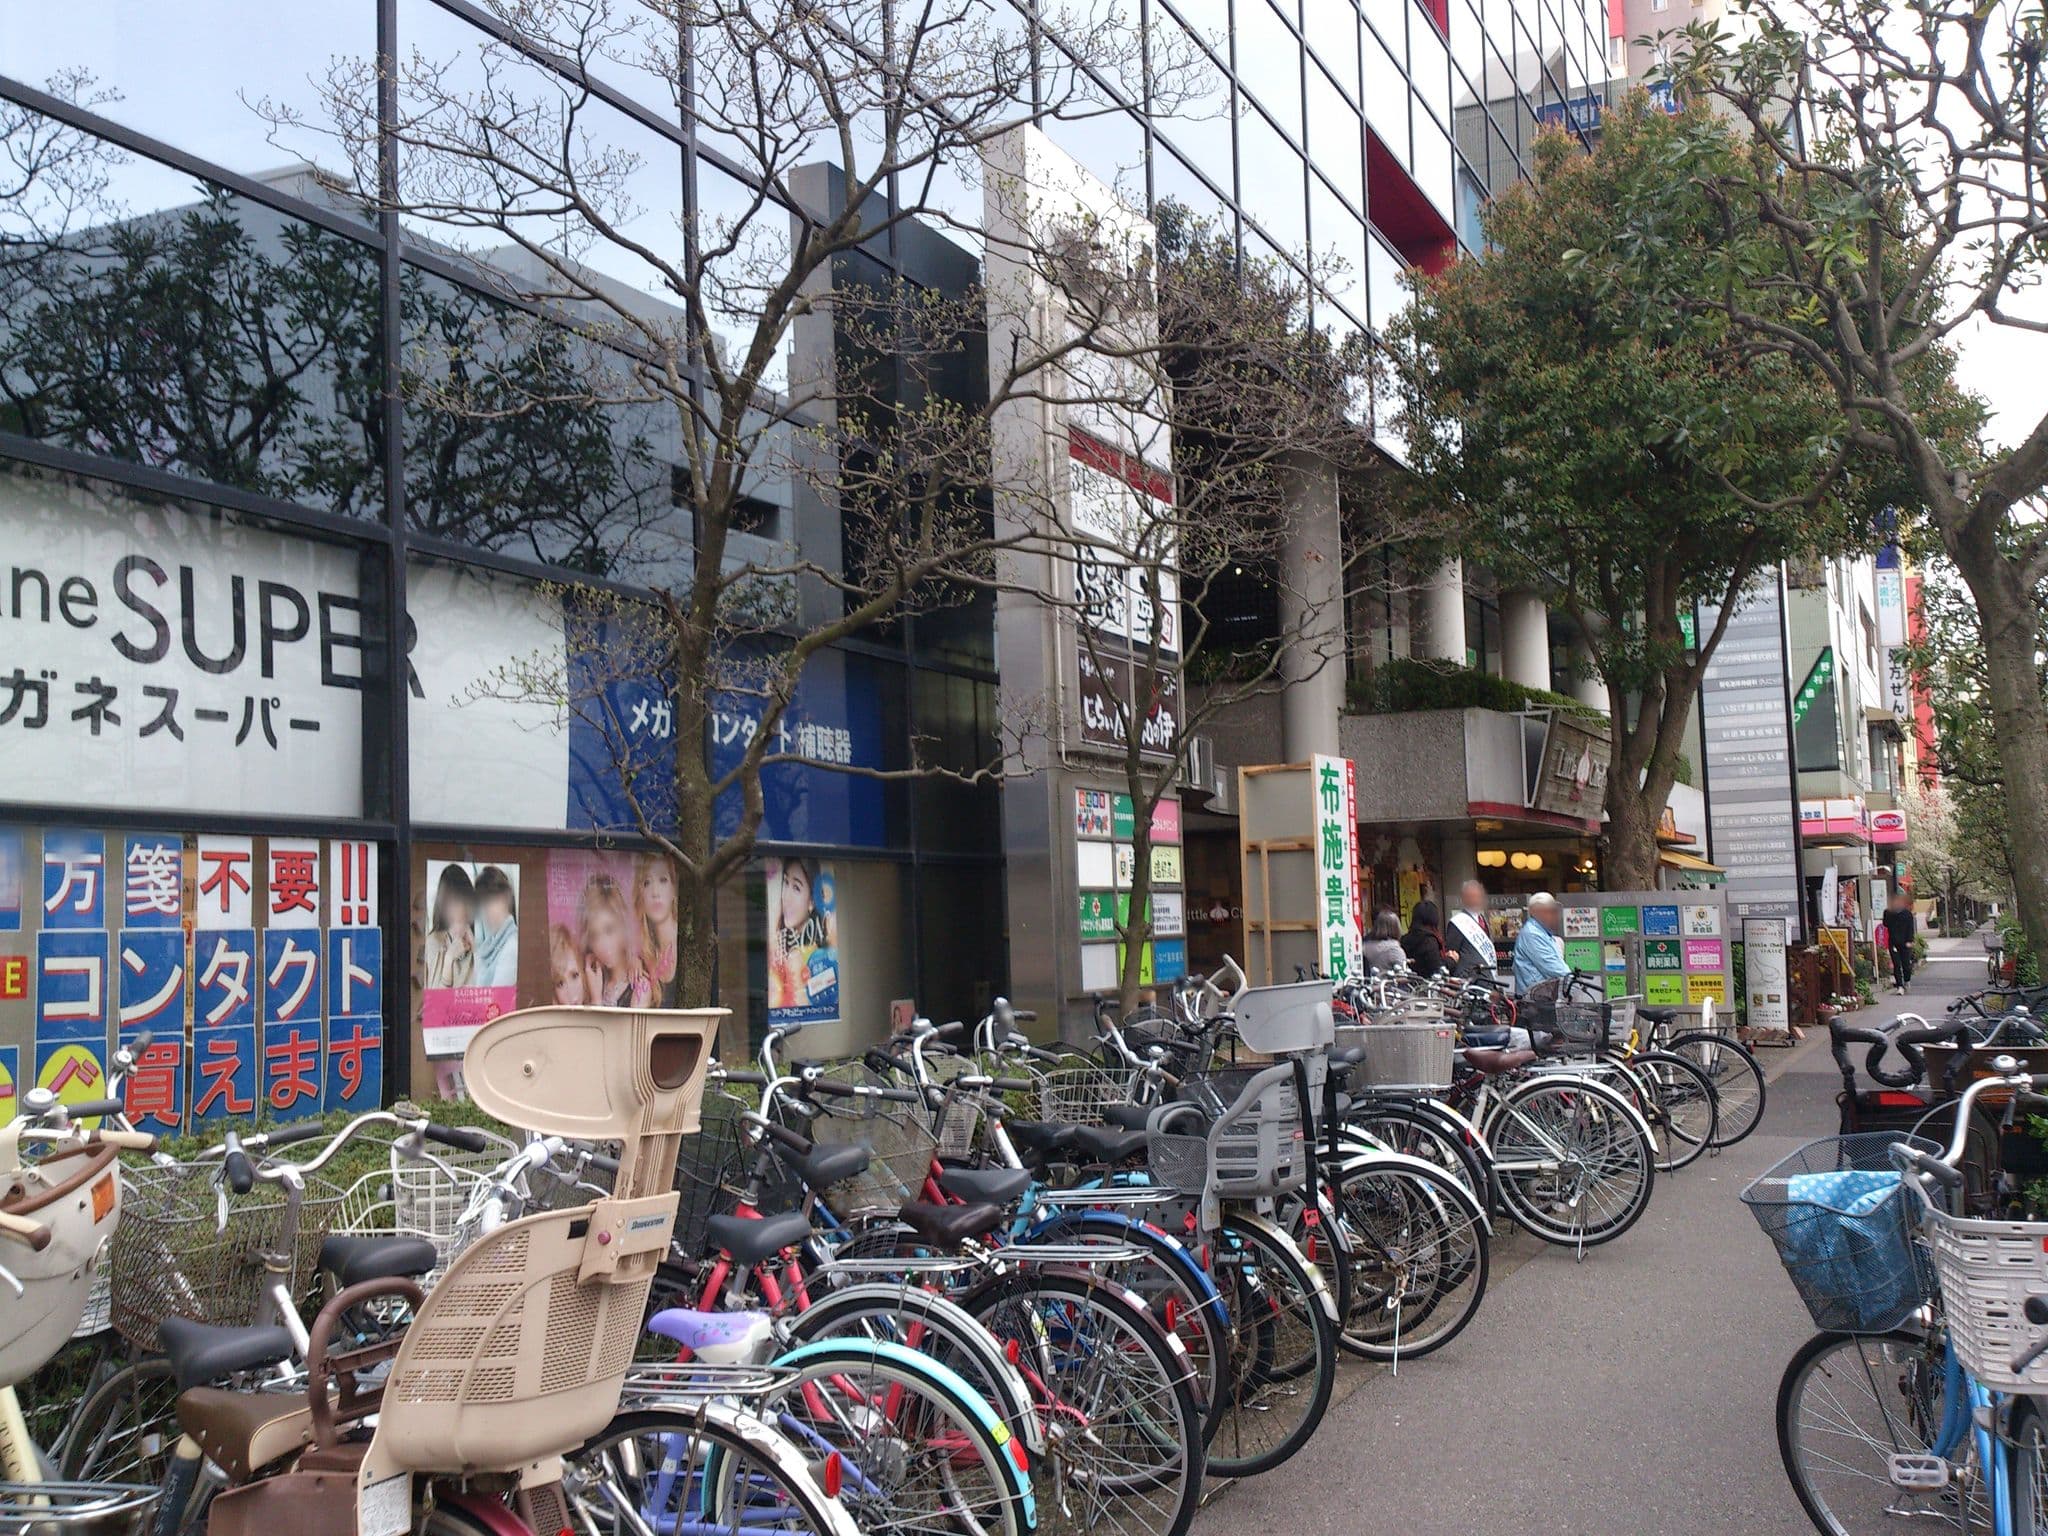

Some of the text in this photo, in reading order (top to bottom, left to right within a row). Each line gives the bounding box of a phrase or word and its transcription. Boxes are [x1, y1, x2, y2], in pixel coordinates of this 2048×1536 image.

[629, 698, 677, 739] メガ
[800, 722, 852, 764] 補聴器
[0, 842, 369, 926] 方箋不要!!
[1320, 761, 1347, 986] 布施貴良
[43, 938, 374, 1025] コンタクト
